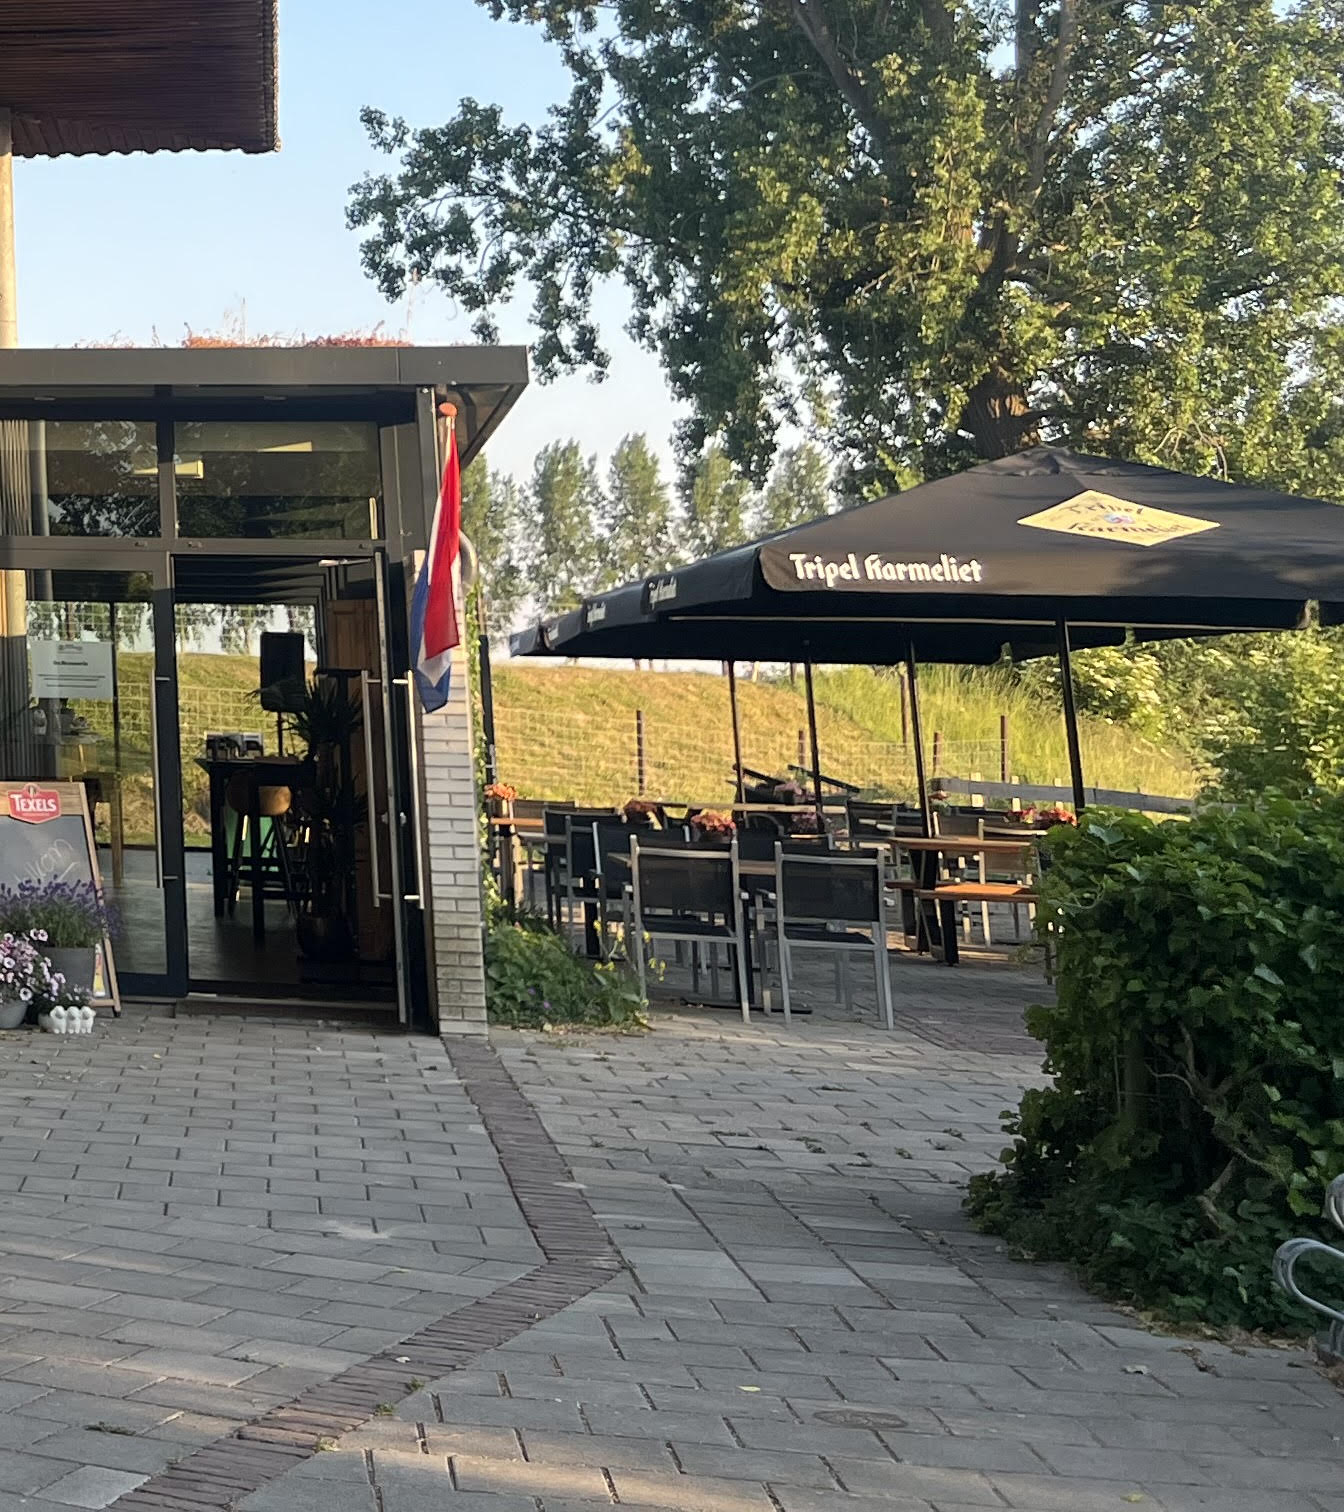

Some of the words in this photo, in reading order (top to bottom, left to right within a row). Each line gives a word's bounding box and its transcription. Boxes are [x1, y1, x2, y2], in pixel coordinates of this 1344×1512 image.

[789, 553, 861, 588] Tripel
[864, 553, 983, 583] Karmeliet
[10, 793, 57, 812] TEXELS
